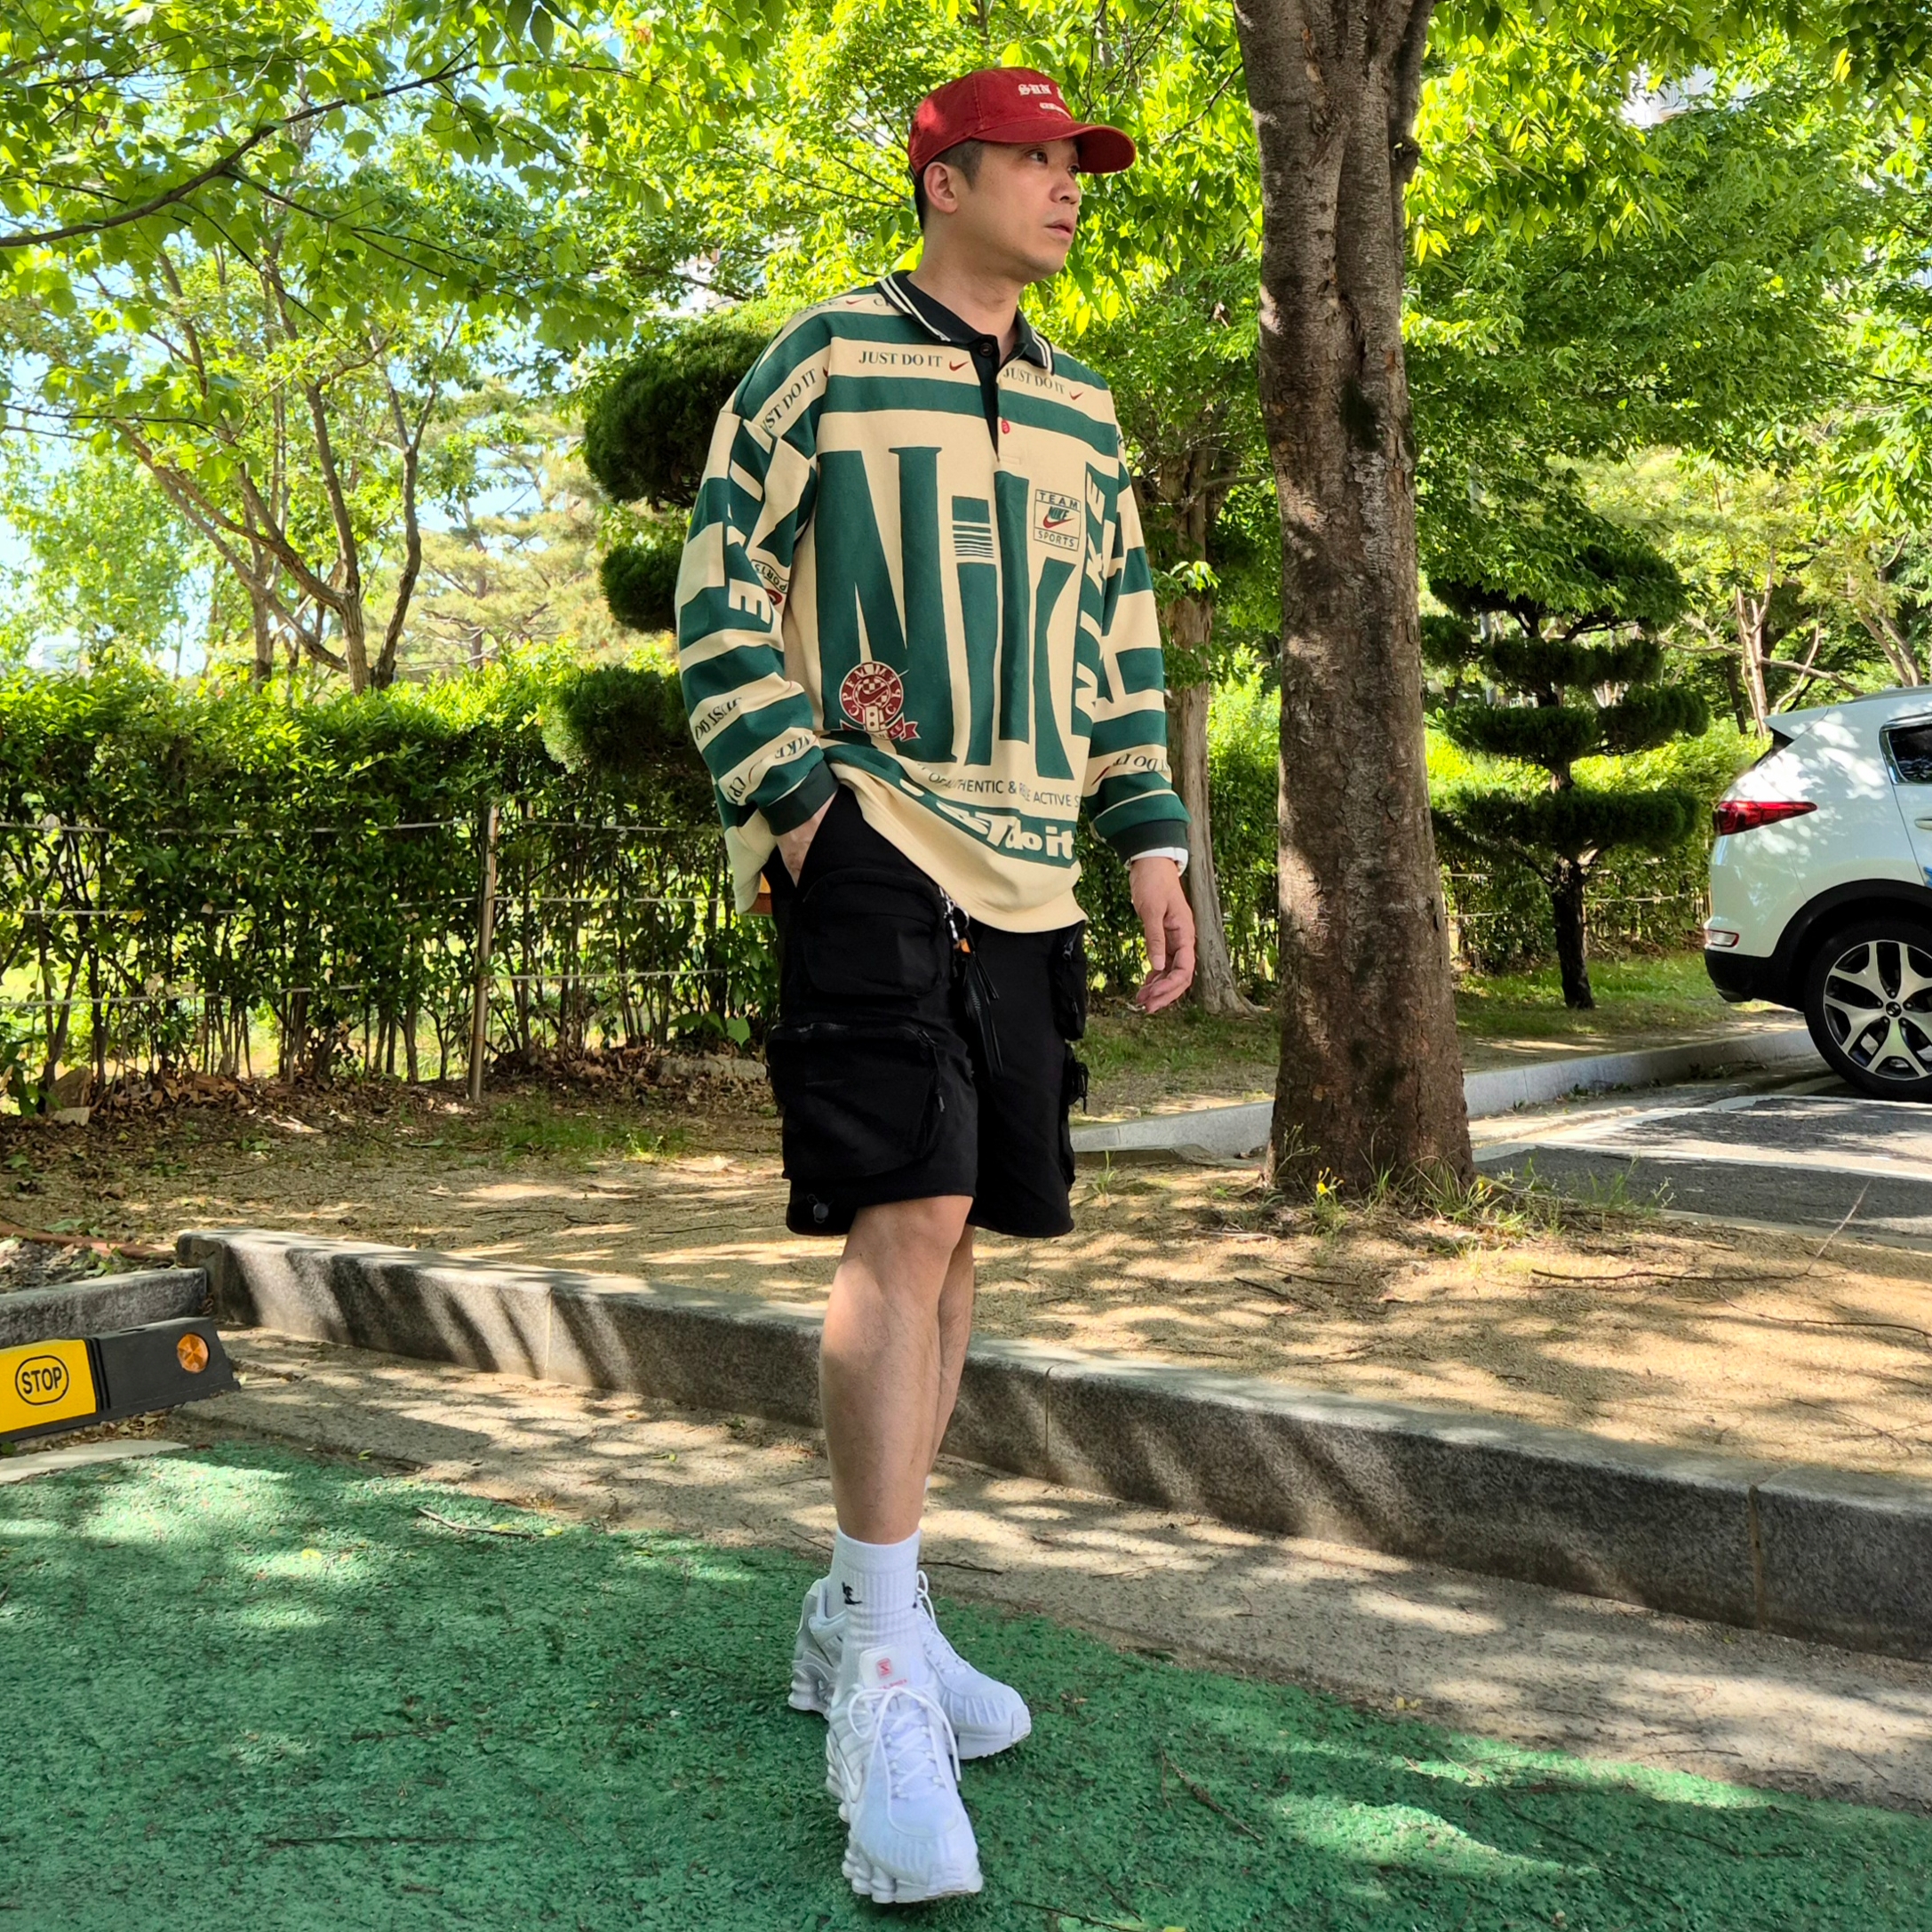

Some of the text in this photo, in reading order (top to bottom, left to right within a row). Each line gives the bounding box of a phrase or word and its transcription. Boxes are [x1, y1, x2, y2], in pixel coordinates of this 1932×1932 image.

[858, 350, 943, 367] JUST DO IT
[782, 383, 802, 410] DO
[802, 369, 817, 388] IT
[1003, 368, 1066, 395] JUST DO IT
[1039, 491, 1078, 510] TEAM
[1038, 531, 1074, 547] SPORTS
[754, 563, 788, 592] PORTS
[1133, 755, 1158, 771] DO
[1008, 781, 1017, 794] &
[1034, 790, 1072, 808] ACTIVE
[1045, 825, 1074, 860] it
[21, 1366, 62, 1394] STOP
